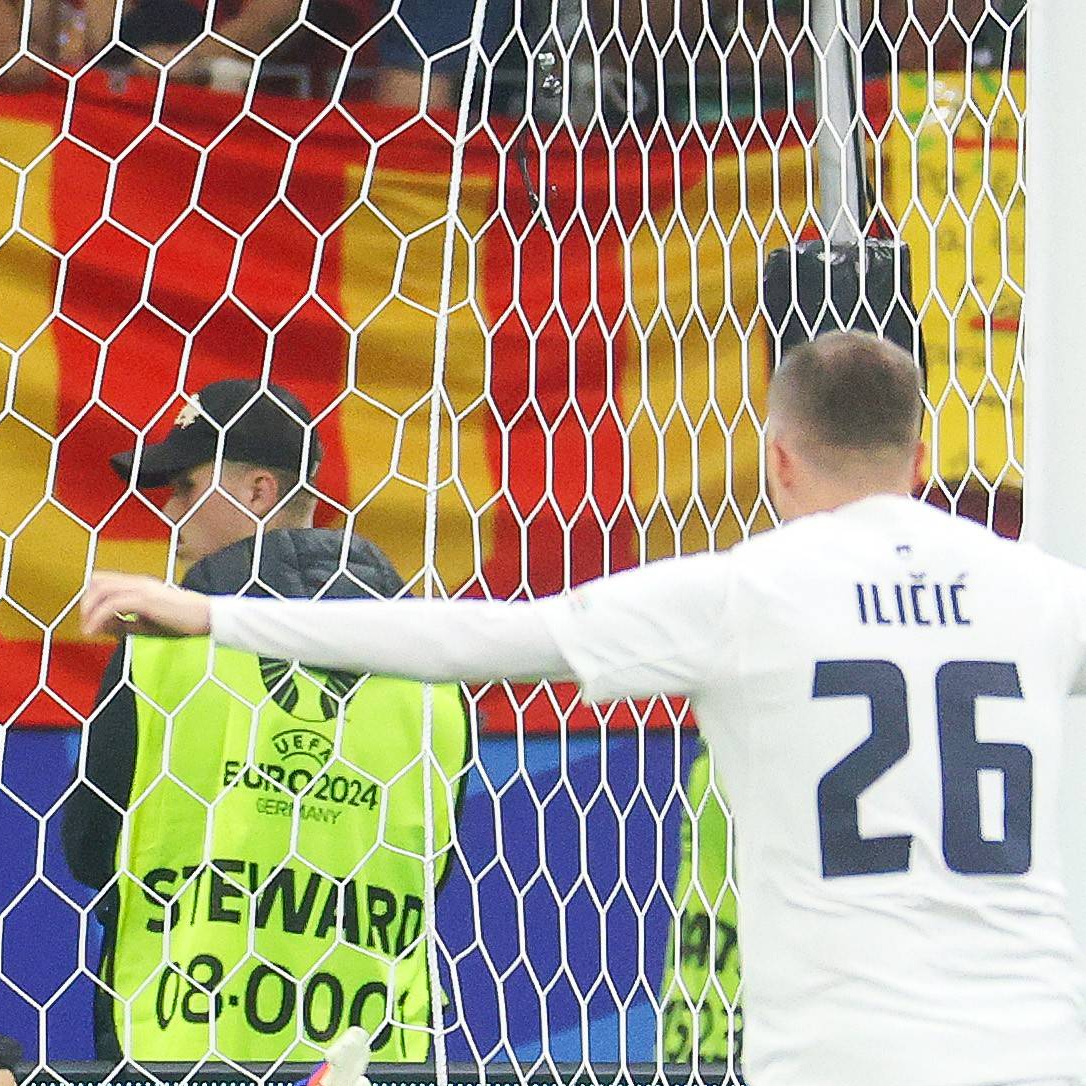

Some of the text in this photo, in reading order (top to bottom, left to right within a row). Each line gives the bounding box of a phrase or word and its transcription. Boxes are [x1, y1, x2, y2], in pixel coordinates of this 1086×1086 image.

[855, 570, 971, 626] ILIČIĆ
[274, 735, 332, 764] UEFA
[812, 659, 1032, 878] 26
[142, 858, 425, 958] STEWARD
